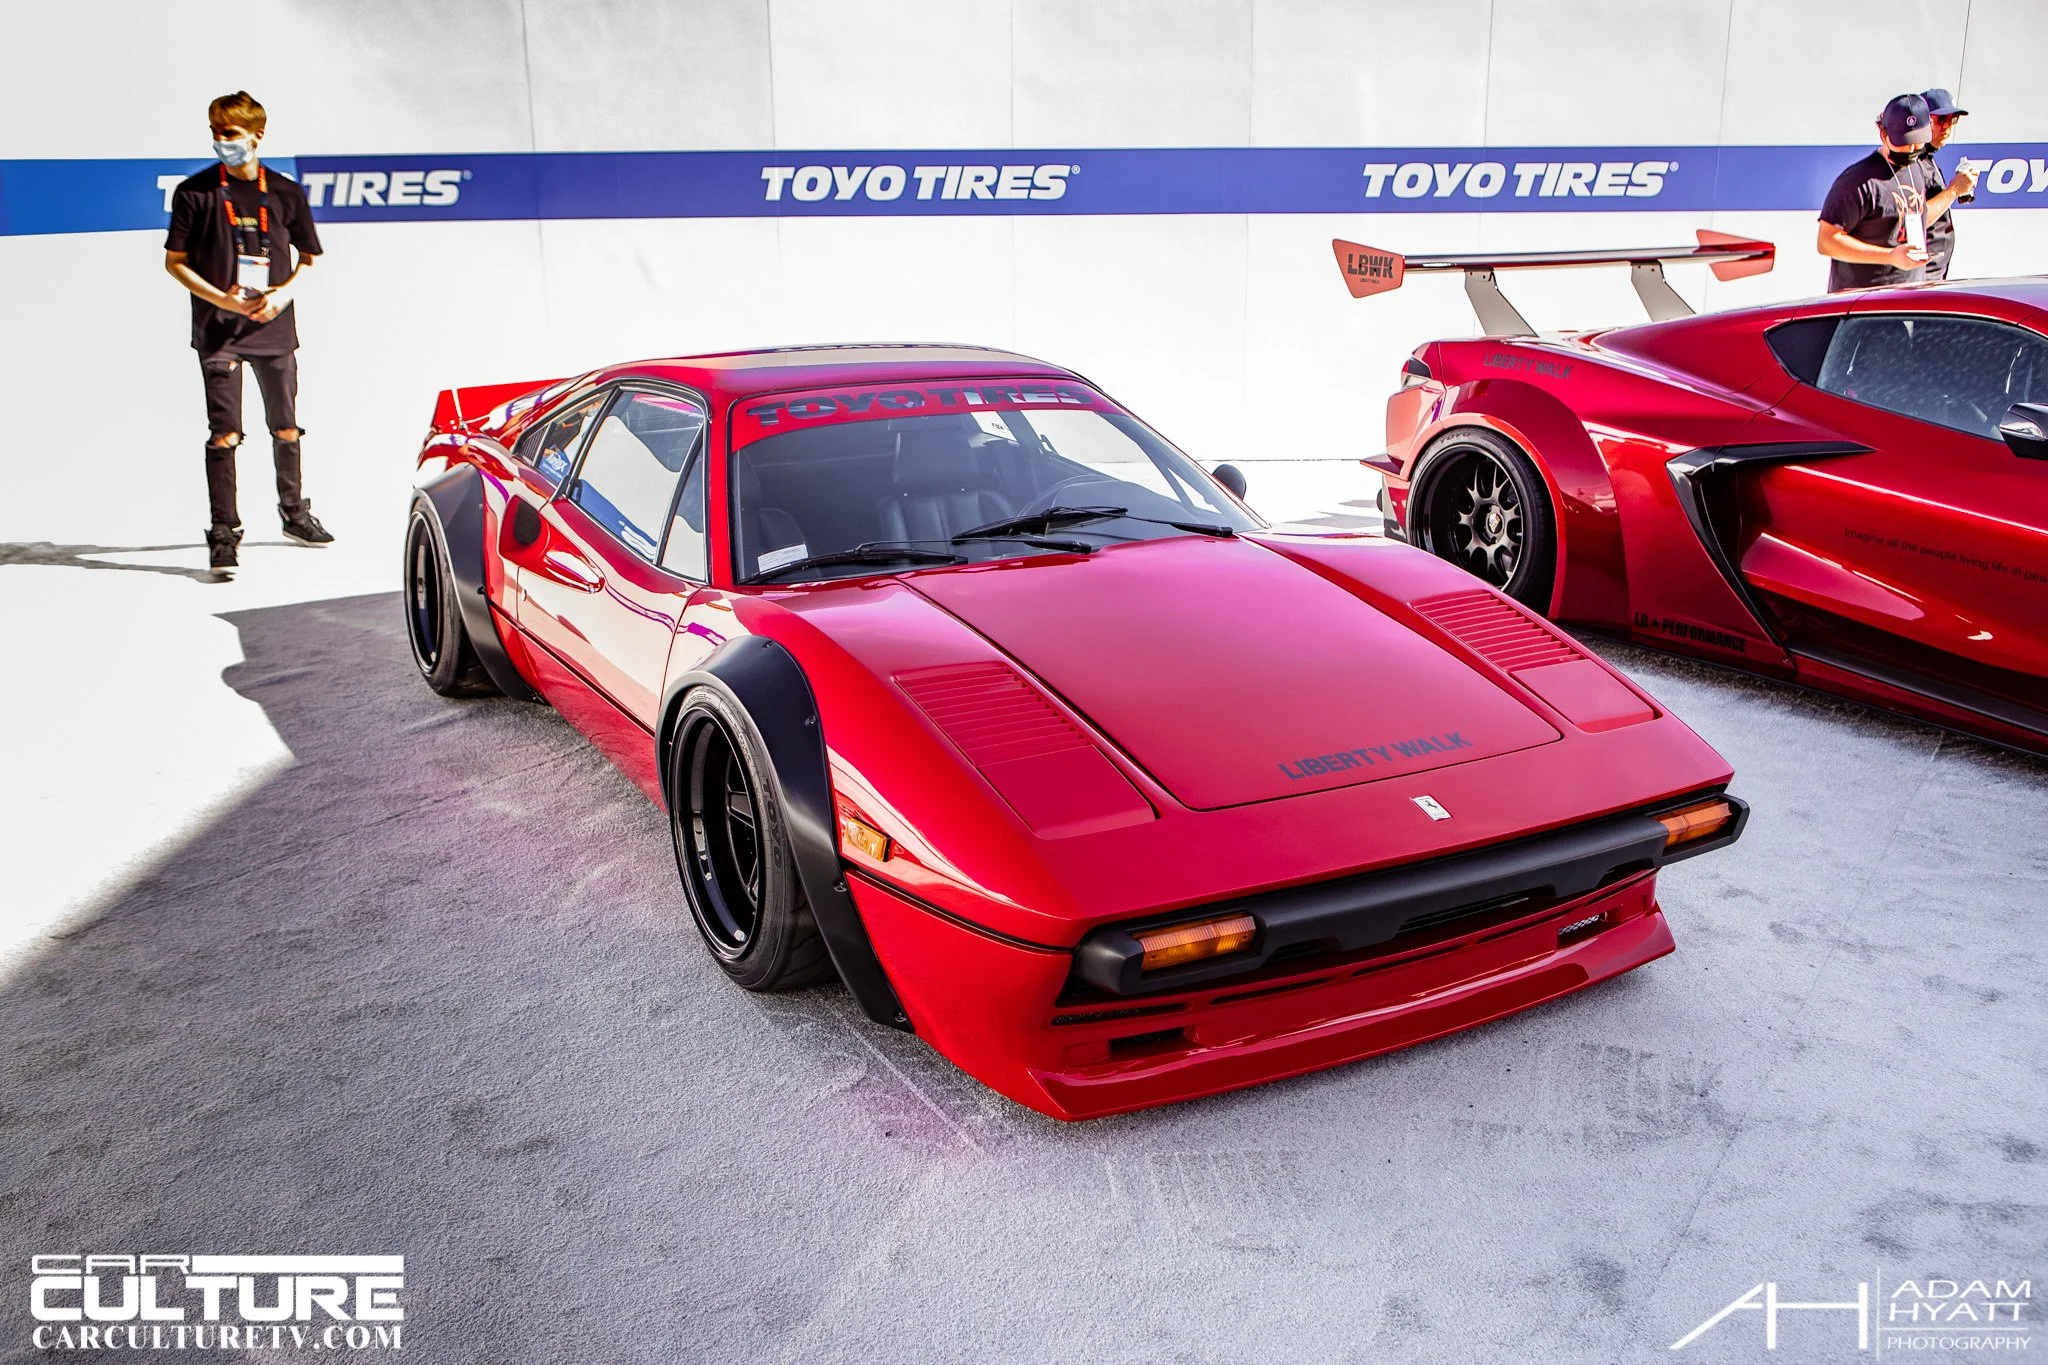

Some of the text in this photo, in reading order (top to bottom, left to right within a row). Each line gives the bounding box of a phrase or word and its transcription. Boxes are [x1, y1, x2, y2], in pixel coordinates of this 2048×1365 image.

[760, 165, 907, 202] TOYO
[1362, 162, 1507, 199] TOYO
[1347, 252, 1395, 279] LBWK
[1483, 351, 1575, 380] LIBERTY WALK
[746, 384, 1093, 427] TOYO TIRES
[1634, 611, 1746, 652] LB PERFORMANCE
[1277, 731, 1473, 780] LIBERTY WALK
